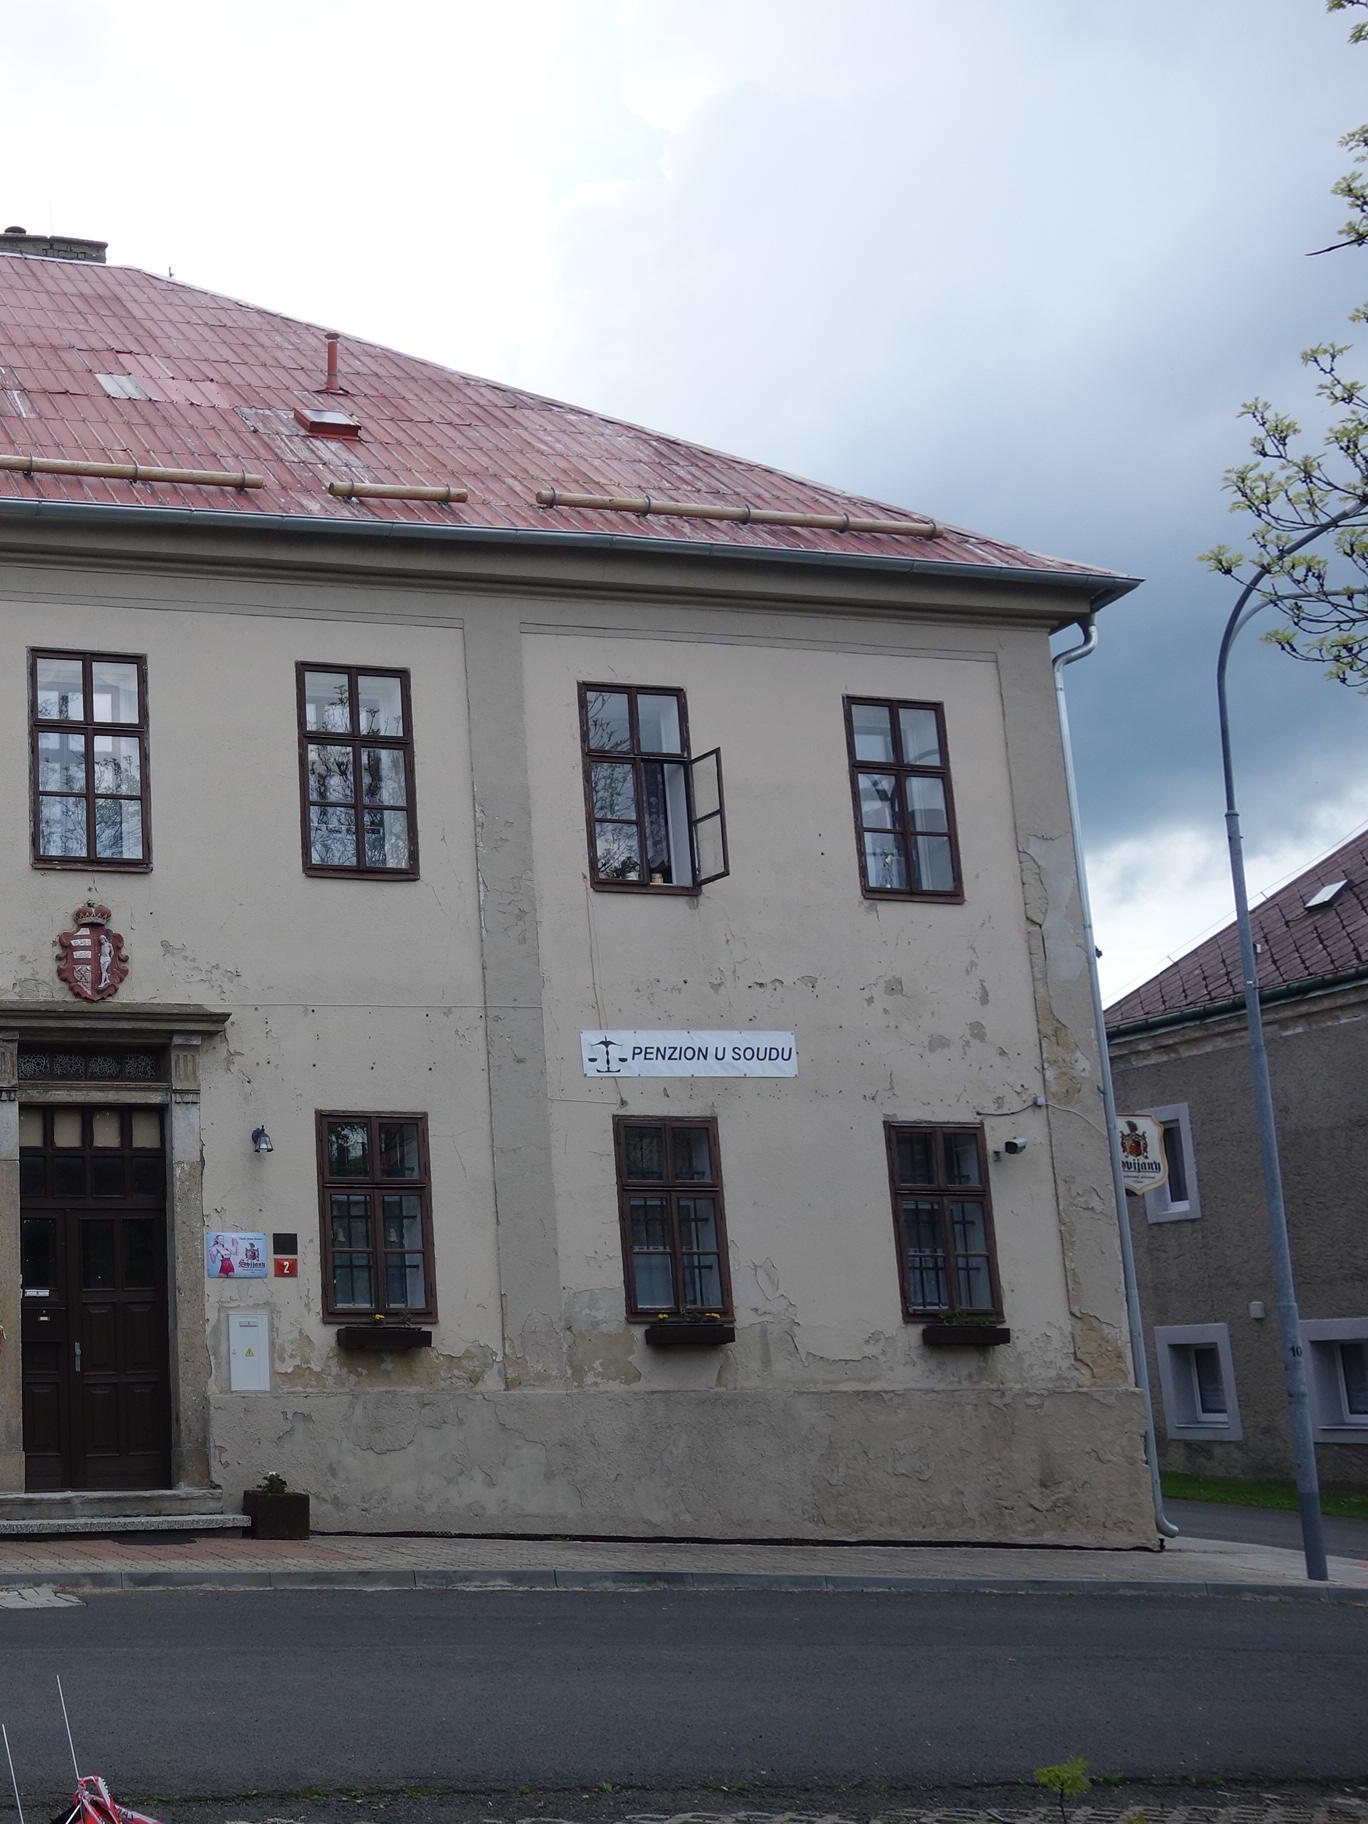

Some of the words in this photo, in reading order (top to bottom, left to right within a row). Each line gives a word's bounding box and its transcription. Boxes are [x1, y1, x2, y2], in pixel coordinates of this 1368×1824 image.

[631, 1046, 709, 1061] PENZION
[714, 1047, 726, 1061] U
[731, 1047, 792, 1061] SOUDU
[283, 1261, 290, 1273] 2
[1289, 1345, 1303, 1358] 10
